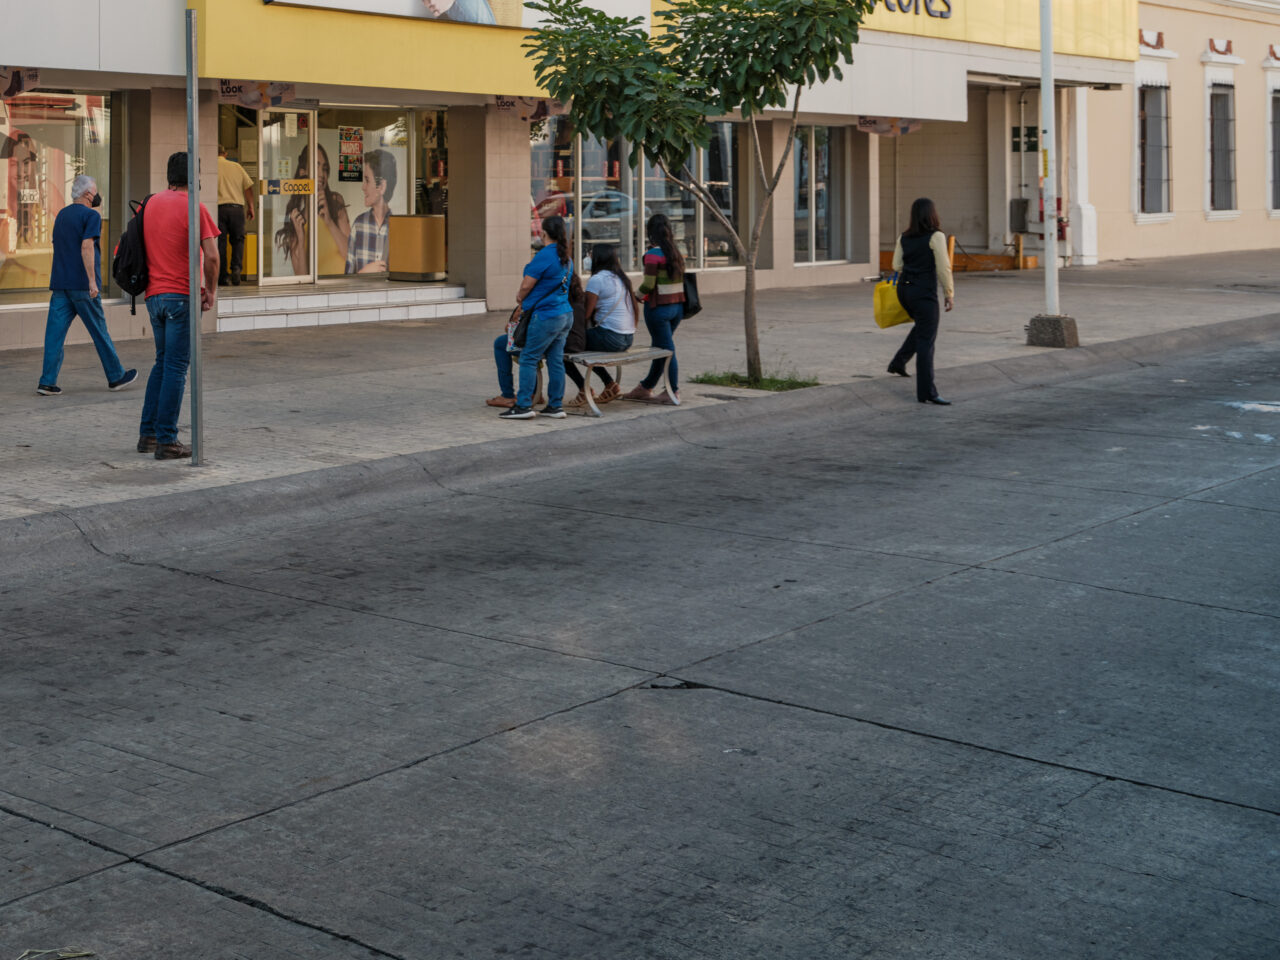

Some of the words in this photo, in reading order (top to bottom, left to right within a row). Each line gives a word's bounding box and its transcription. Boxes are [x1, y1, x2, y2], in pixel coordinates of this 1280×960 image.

[221, 86, 243, 94] LOOK
[341, 142, 360, 154] MARVEL
[283, 182, 310, 191] Coppel
